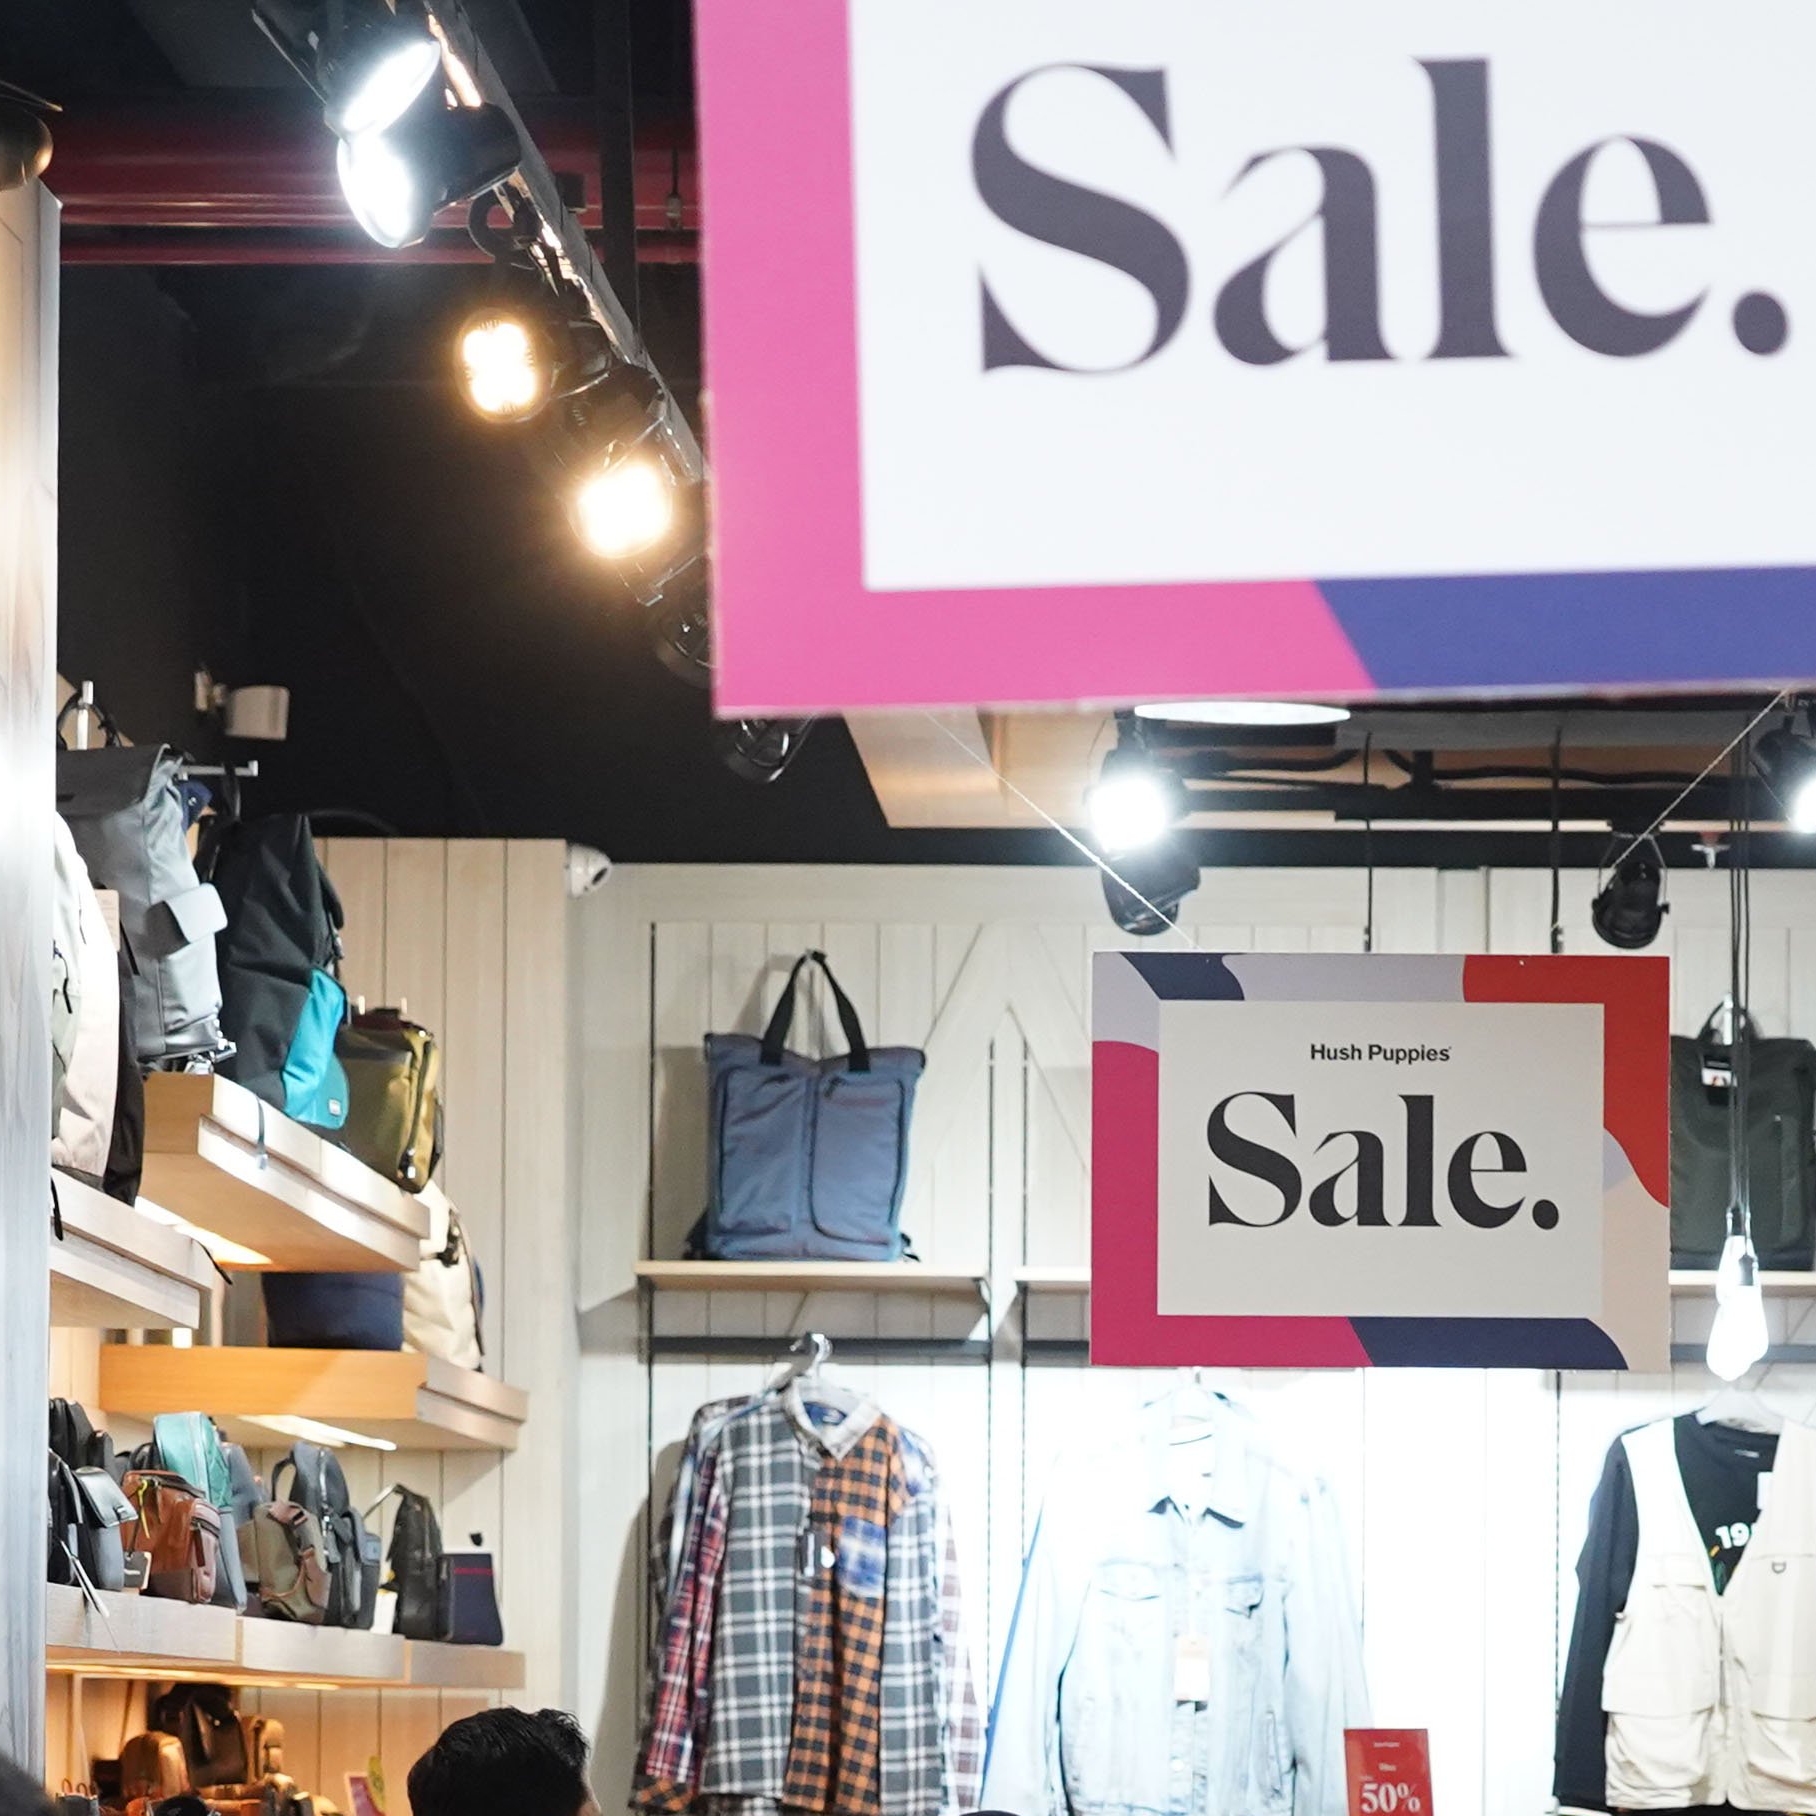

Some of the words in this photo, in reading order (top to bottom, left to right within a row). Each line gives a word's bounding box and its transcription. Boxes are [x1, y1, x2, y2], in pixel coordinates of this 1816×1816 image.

[972, 58, 1788, 372] Sale.
[1310, 1043, 1363, 1061] Hush
[1368, 1043, 1451, 1065] Puppies
[1207, 1091, 1559, 1230] Sale.
[1361, 1782, 1421, 1814] 50%
